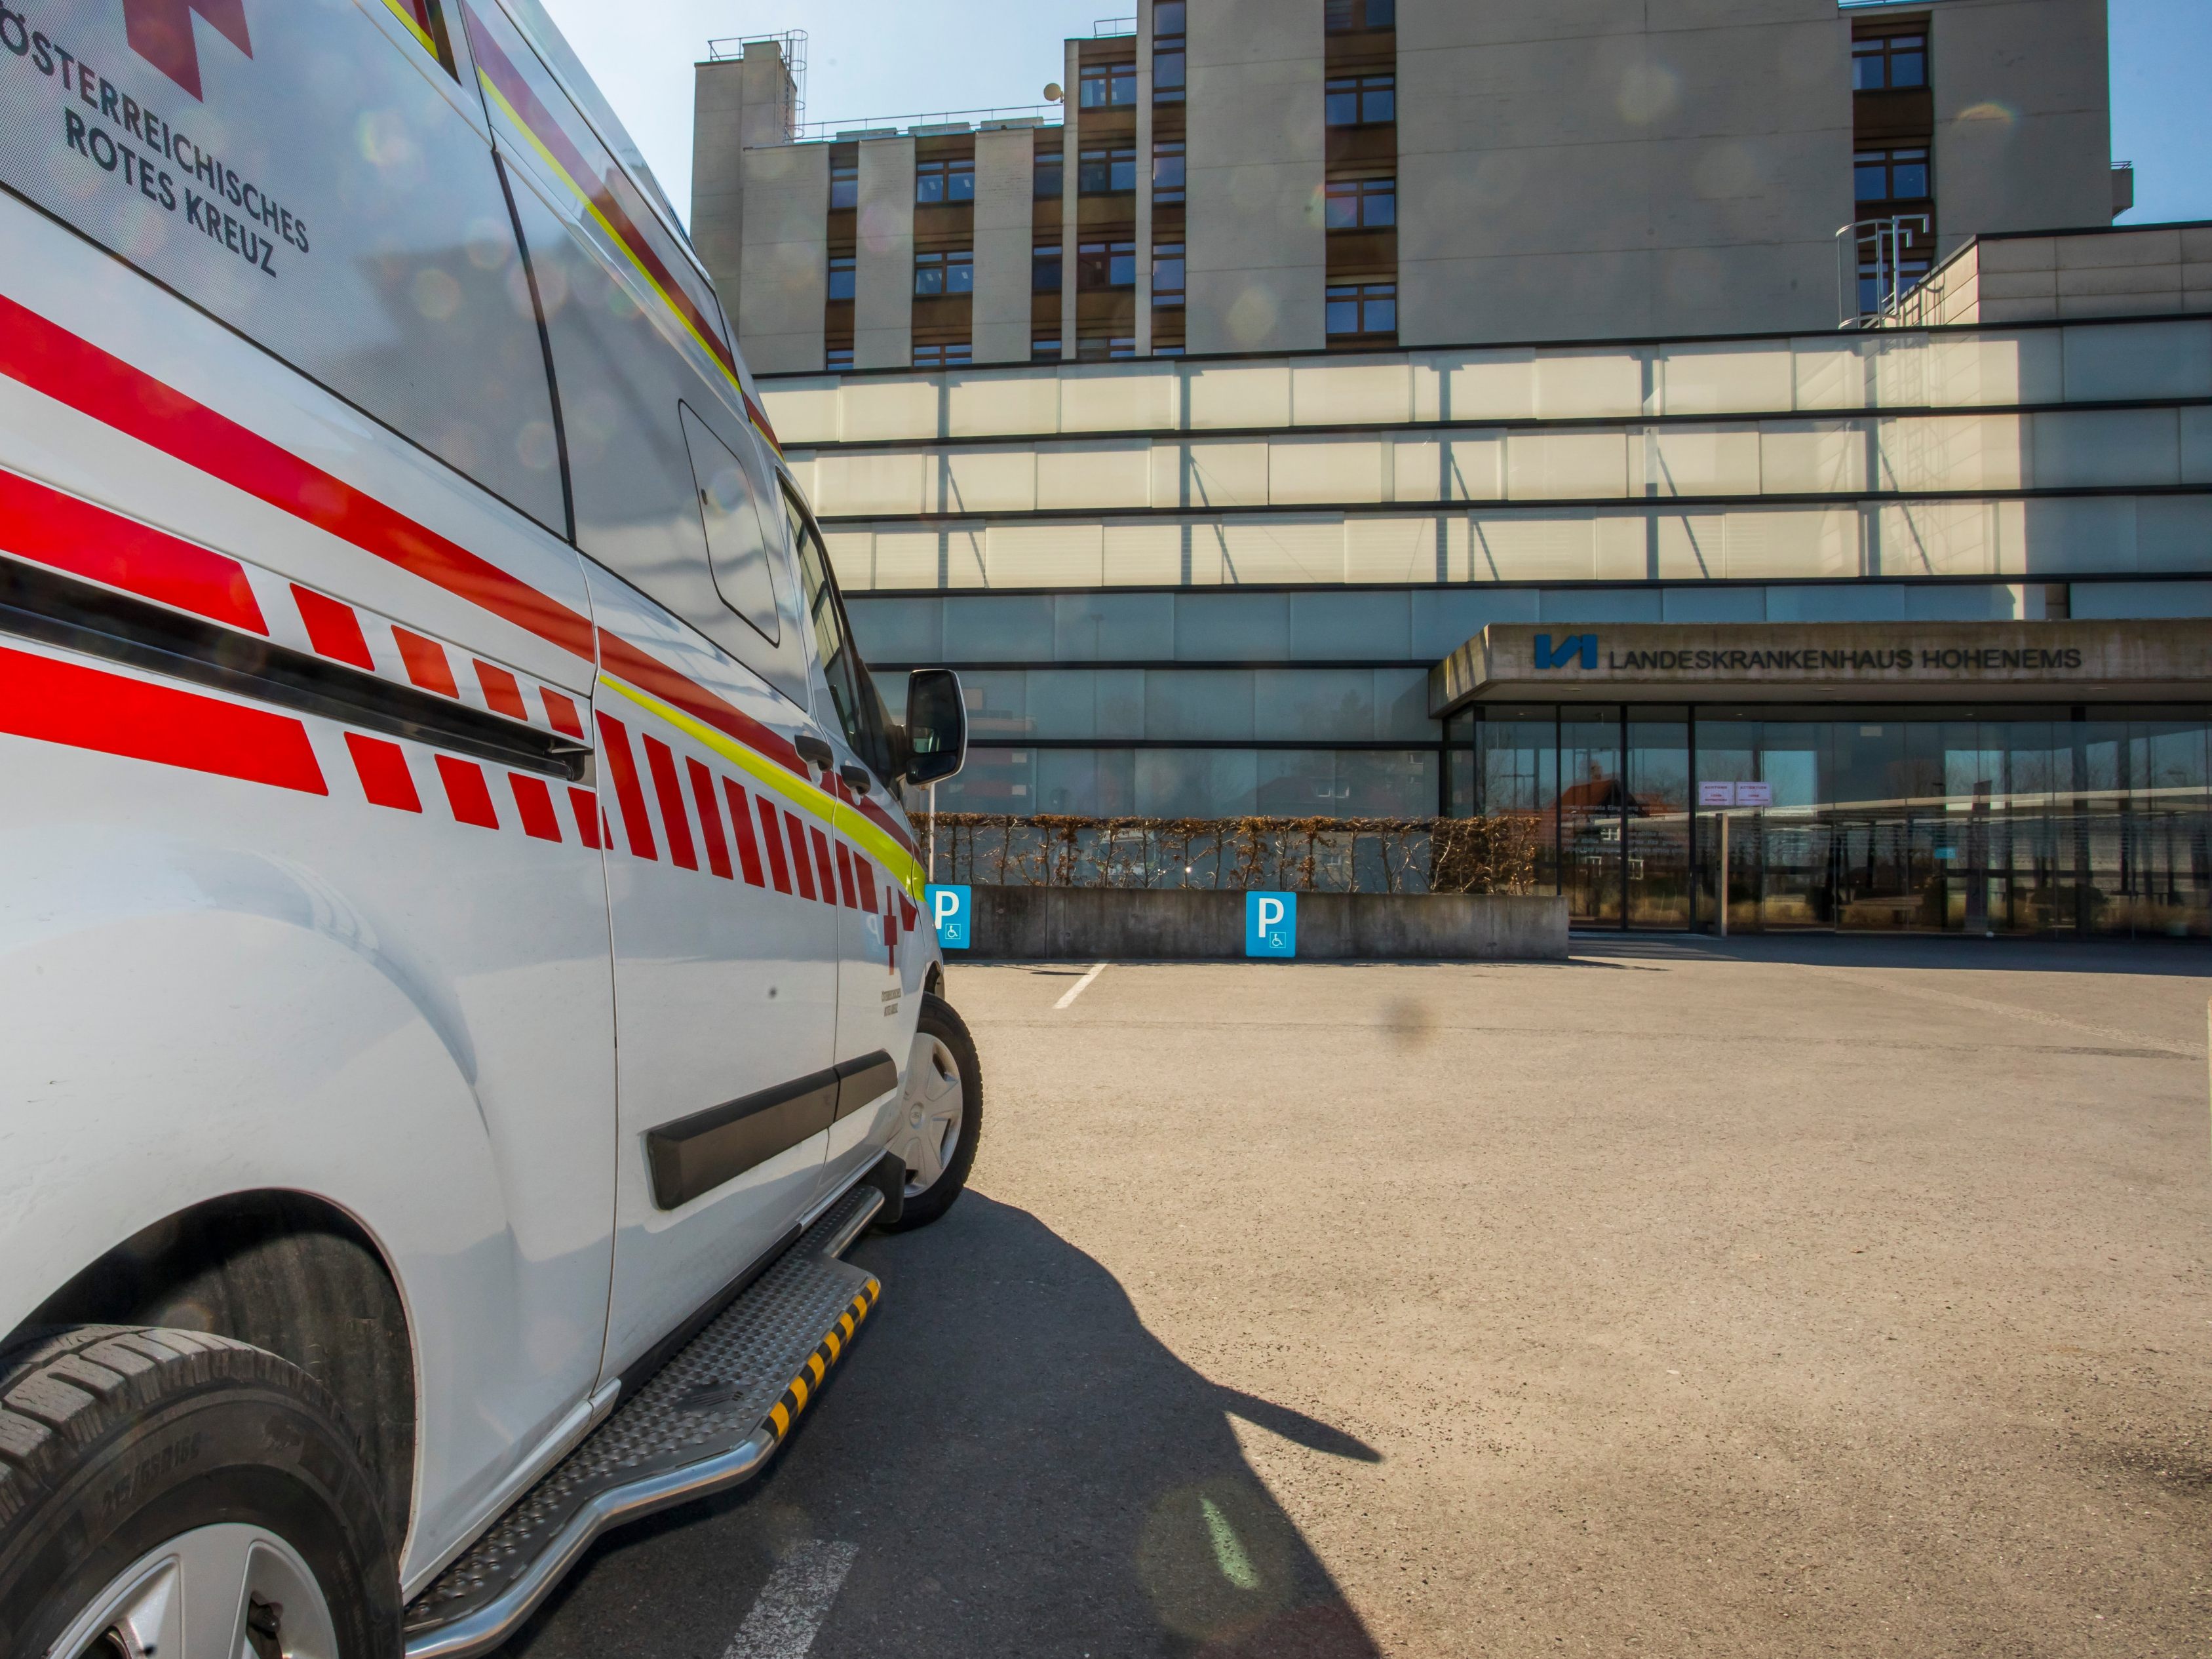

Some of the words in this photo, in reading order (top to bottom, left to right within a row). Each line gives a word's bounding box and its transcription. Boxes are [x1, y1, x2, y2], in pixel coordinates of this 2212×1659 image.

[0, 0, 309, 254] ÖSTERREICHISCHES
[65, 106, 176, 211] ROTES
[184, 187, 277, 278] KREUZ
[1609, 650, 1913, 669] LANDESKRANKENHAUS
[1922, 649, 2082, 669] HOHENEMS
[935, 891, 960, 929] P
[1258, 897, 1285, 938] P
